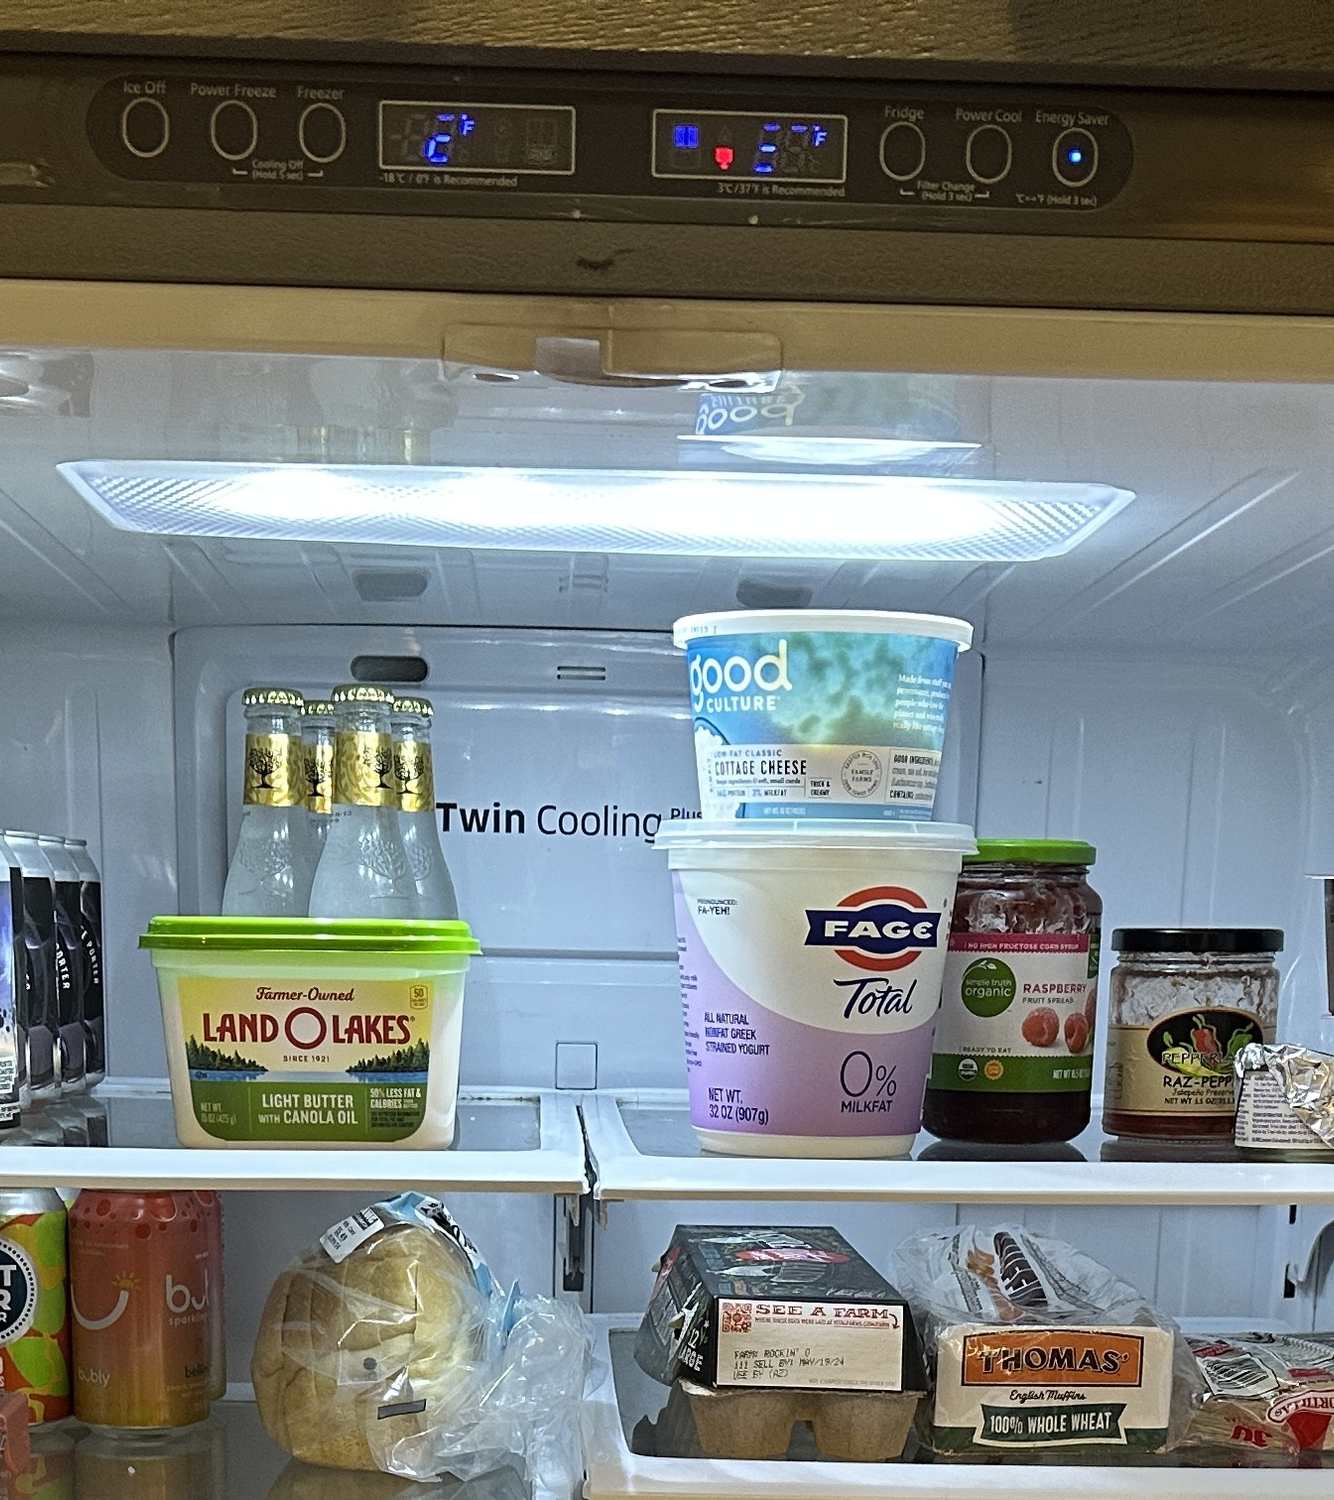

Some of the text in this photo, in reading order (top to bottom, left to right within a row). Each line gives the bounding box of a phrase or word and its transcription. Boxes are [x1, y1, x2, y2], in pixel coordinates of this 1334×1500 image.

[124, 82, 166, 95] Ice Off
[191, 84, 277, 98] Power Freeze
[297, 86, 345, 100] Freezer
[884, 105, 924, 120] Fridge
[955, 108, 1023, 123] Power Cool
[1035, 110, 1110, 127] Energy Saver
[444, 174, 517, 187] Recommended
[772, 184, 845, 197] Recommended
[690, 639, 793, 713] good
[706, 696, 778, 713] CULTURE
[745, 749, 782, 757] CLASSIC
[715, 759, 807, 776] COTTAGE CHEESE
[436, 801, 703, 844] Twin Cooling Plus
[697, 905, 731, 916] FA-YEH!
[824, 920, 934, 940] FAGE
[991, 979, 1012, 987] truth
[1023, 983, 1088, 994] RASPBERRY
[256, 986, 356, 1002] Farmer-Owned
[413, 988, 424, 998] 50
[833, 976, 918, 1019] Total
[965, 986, 1012, 998] organic
[704, 1012, 749, 1025] ALL NATURAL
[203, 1013, 279, 1043] LAND
[332, 1014, 411, 1045] LAKES
[730, 1028, 757, 1041] GREEK
[705, 1041, 770, 1056] STRAINED YOGURT
[311, 1055, 331, 1063] 1921
[840, 1050, 897, 1098] 0%
[1163, 1075, 1234, 1088] RAZ-PEPP
[385, 1088, 403, 1098] LESS
[404, 1088, 415, 1098] FAT
[708, 1087, 743, 1103] NET WT.
[262, 1093, 354, 1109] LIGHT BUTTER
[370, 1099, 403, 1109] CALORIES
[840, 1100, 893, 1114] MILKFAT
[1180, 1097, 1192, 1105] WT
[258, 1114, 281, 1124] WITH
[283, 1110, 335, 1124] CANOLA
[339, 1111, 359, 1125] OIL
[708, 1104, 769, 1126] 32 OZ (907g)
[755, 1303, 890, 1319] SEE A FARM
[687, 1327, 701, 1349] 12
[754, 1359, 774, 1369] SELL
[976, 1343, 1130, 1377] THOMAS'
[1010, 1388, 1087, 1404] English Muffins
[989, 1410, 1113, 1437] 100% WHOLE WHEAT
